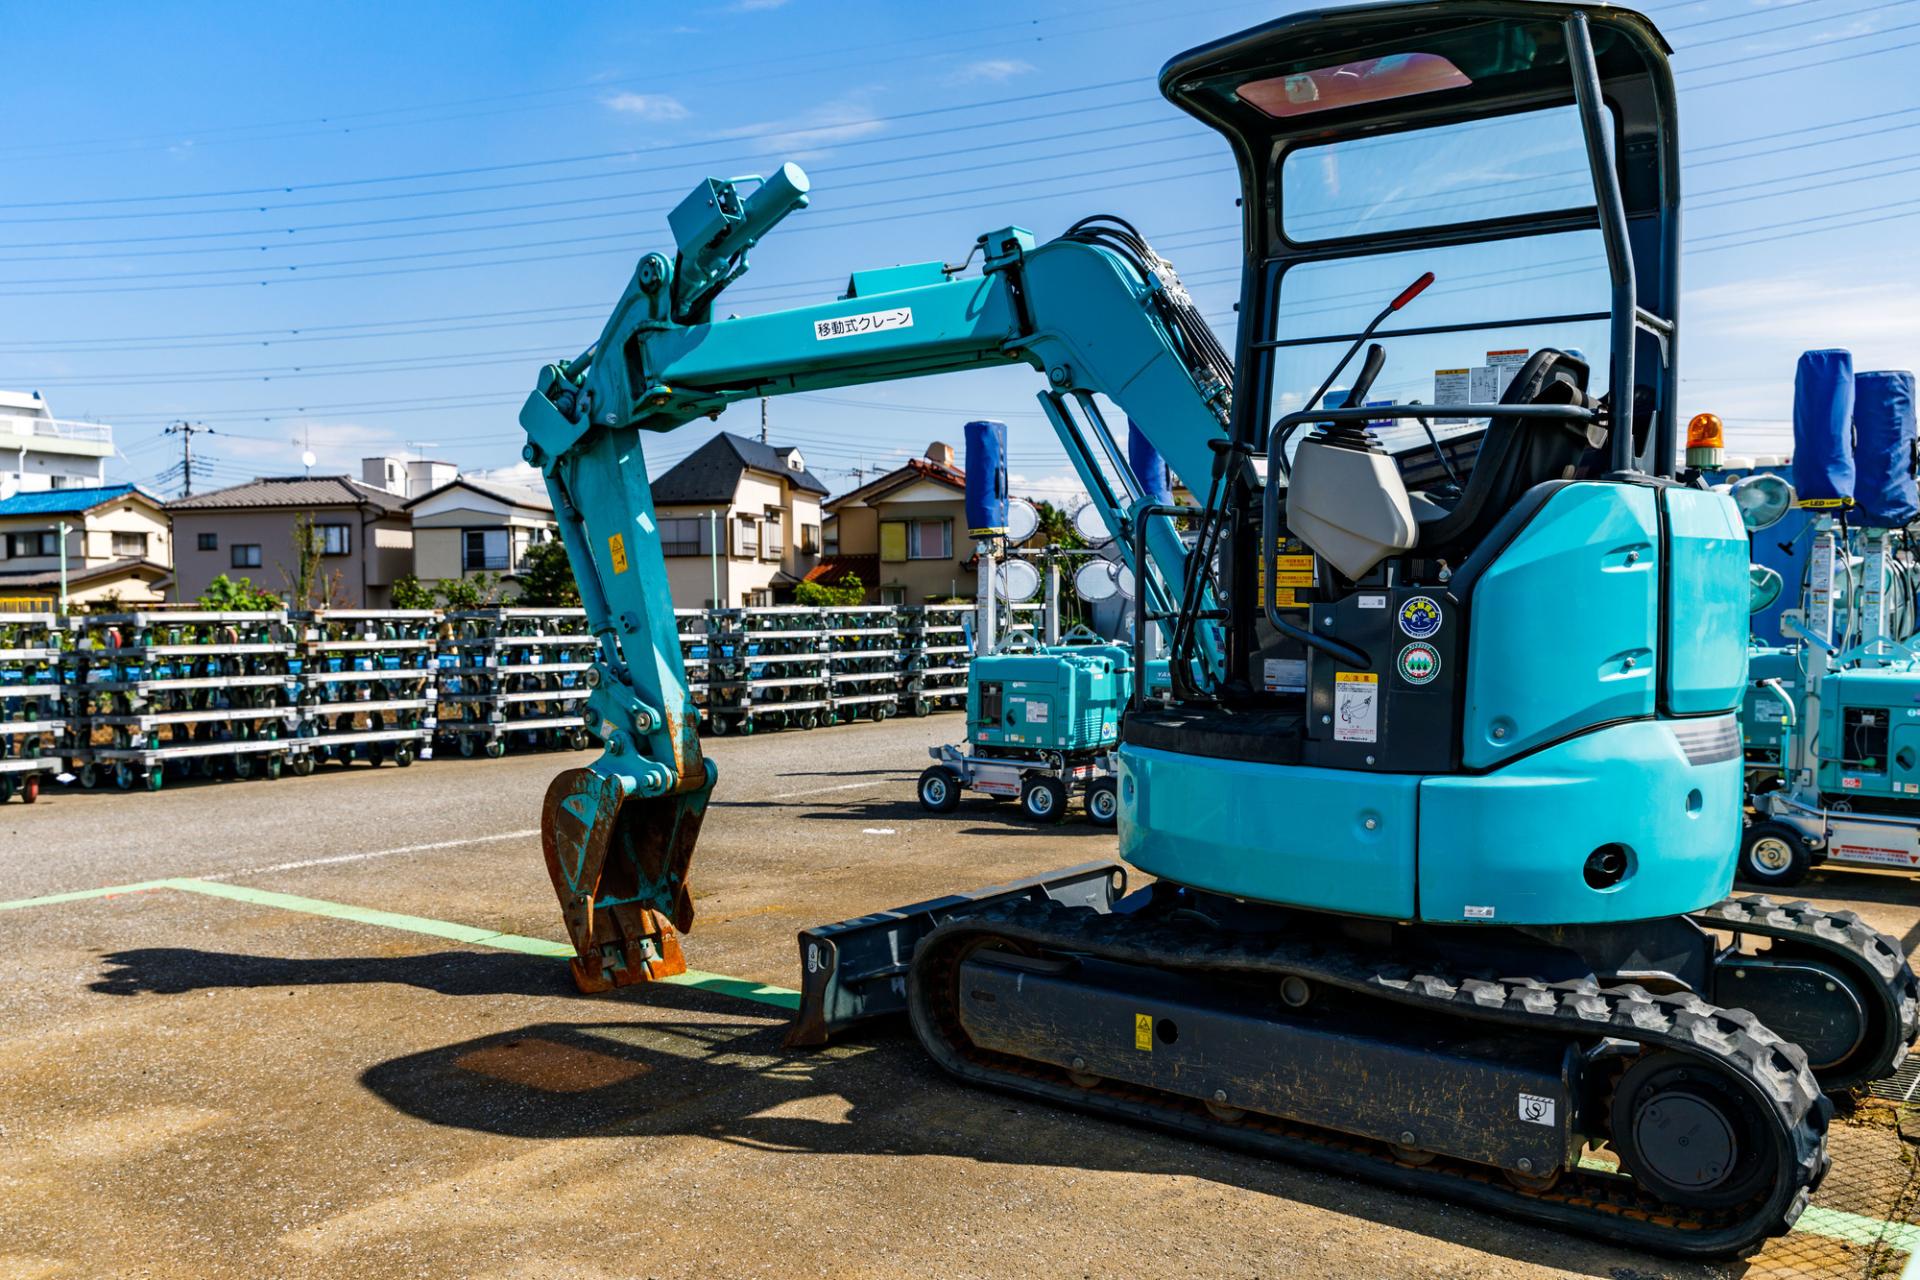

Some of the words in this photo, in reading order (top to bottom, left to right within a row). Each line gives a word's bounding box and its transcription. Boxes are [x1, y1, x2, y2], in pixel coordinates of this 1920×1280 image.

[817, 312, 910, 337] 移動式クレーン
